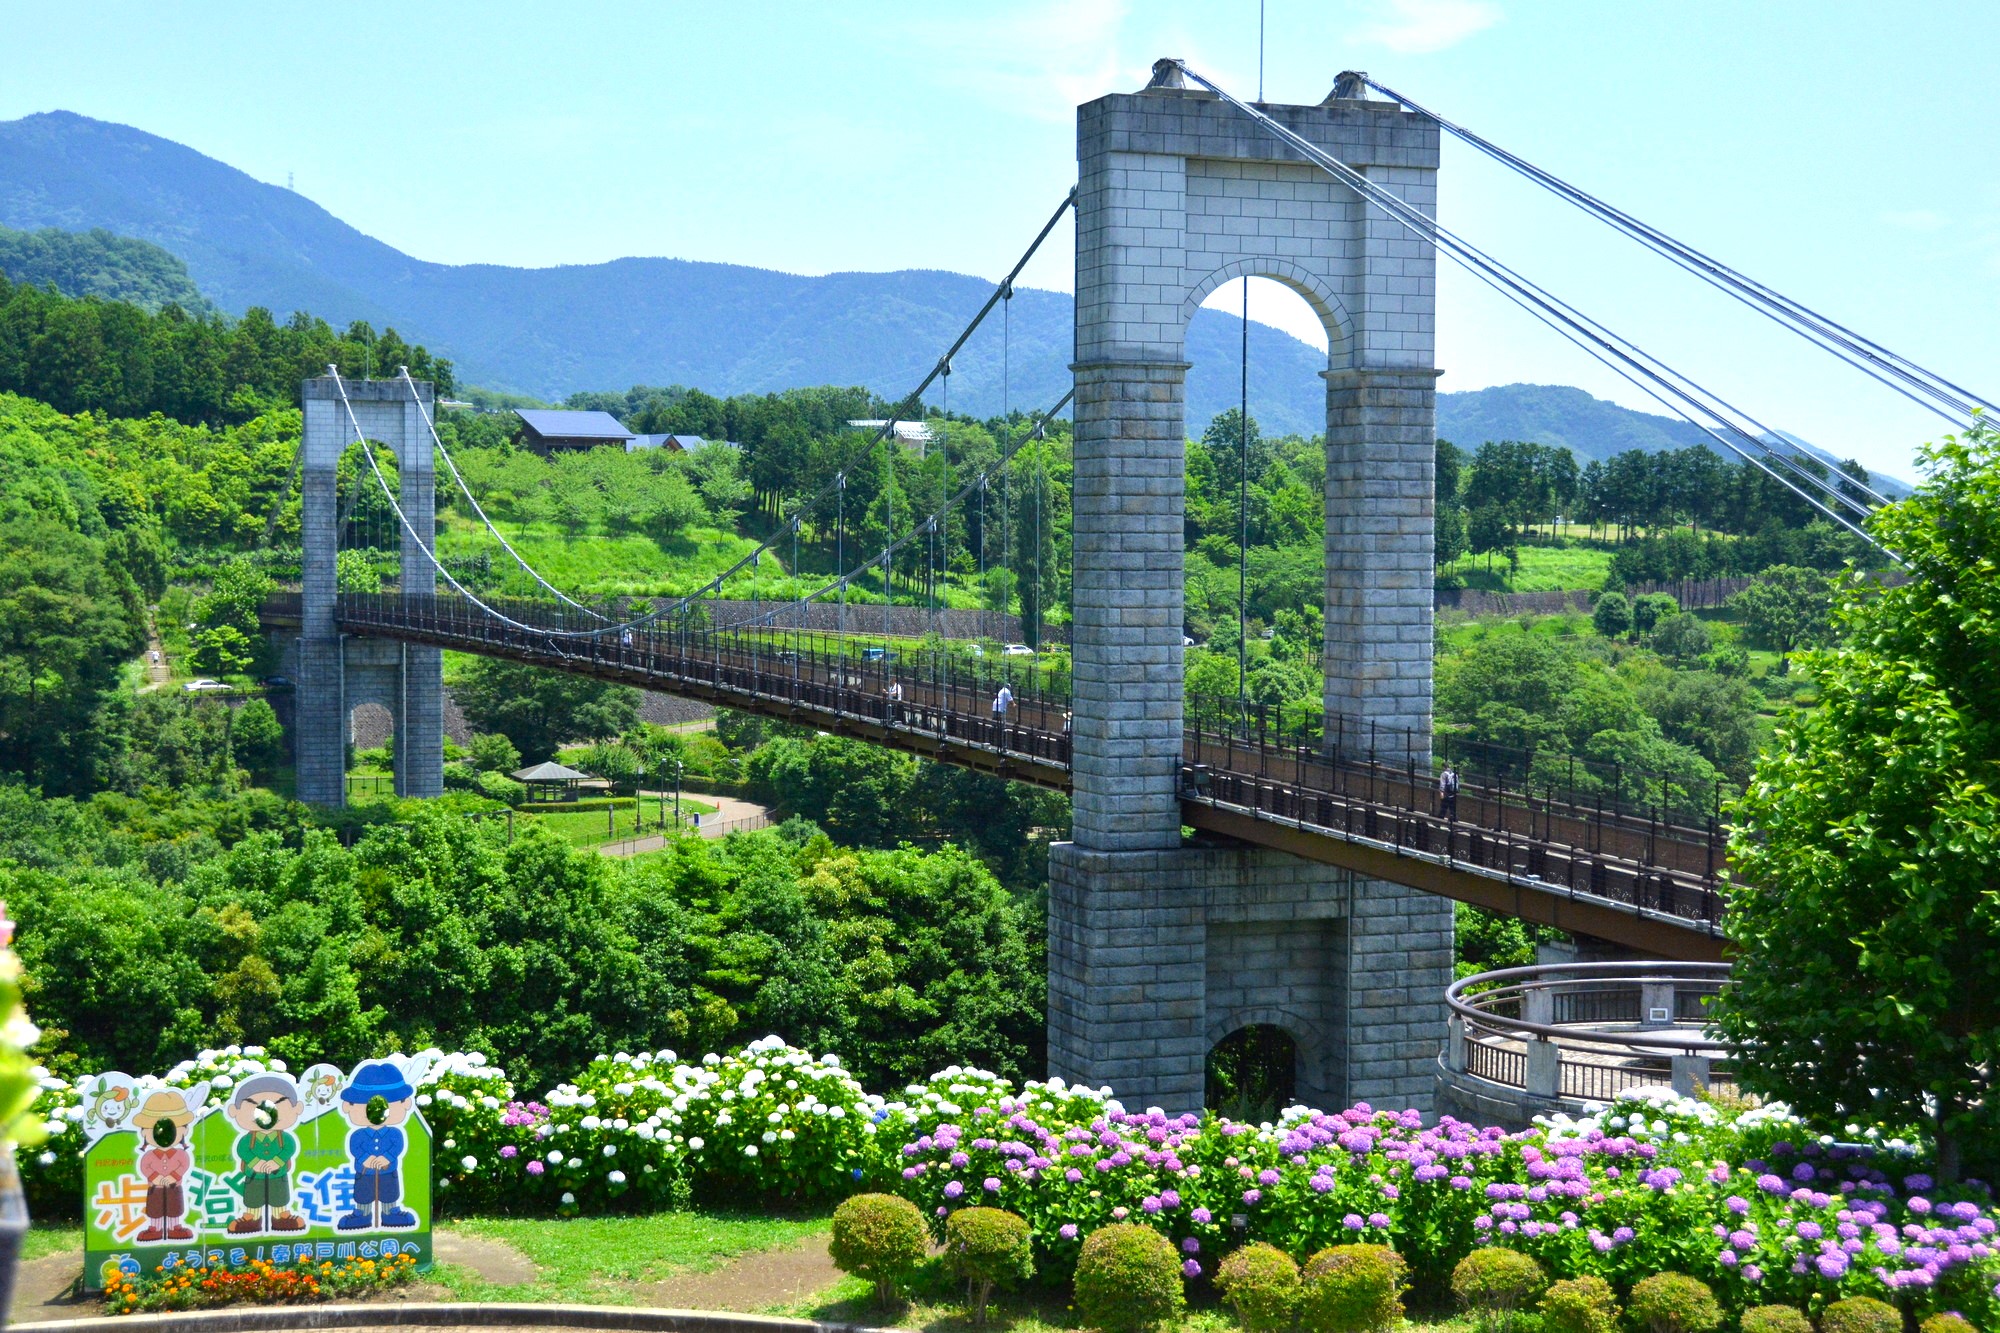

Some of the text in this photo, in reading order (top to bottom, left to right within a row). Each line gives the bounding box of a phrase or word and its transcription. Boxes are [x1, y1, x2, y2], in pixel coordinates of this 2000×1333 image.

[96, 1167, 355, 1237] 歩 登 進
